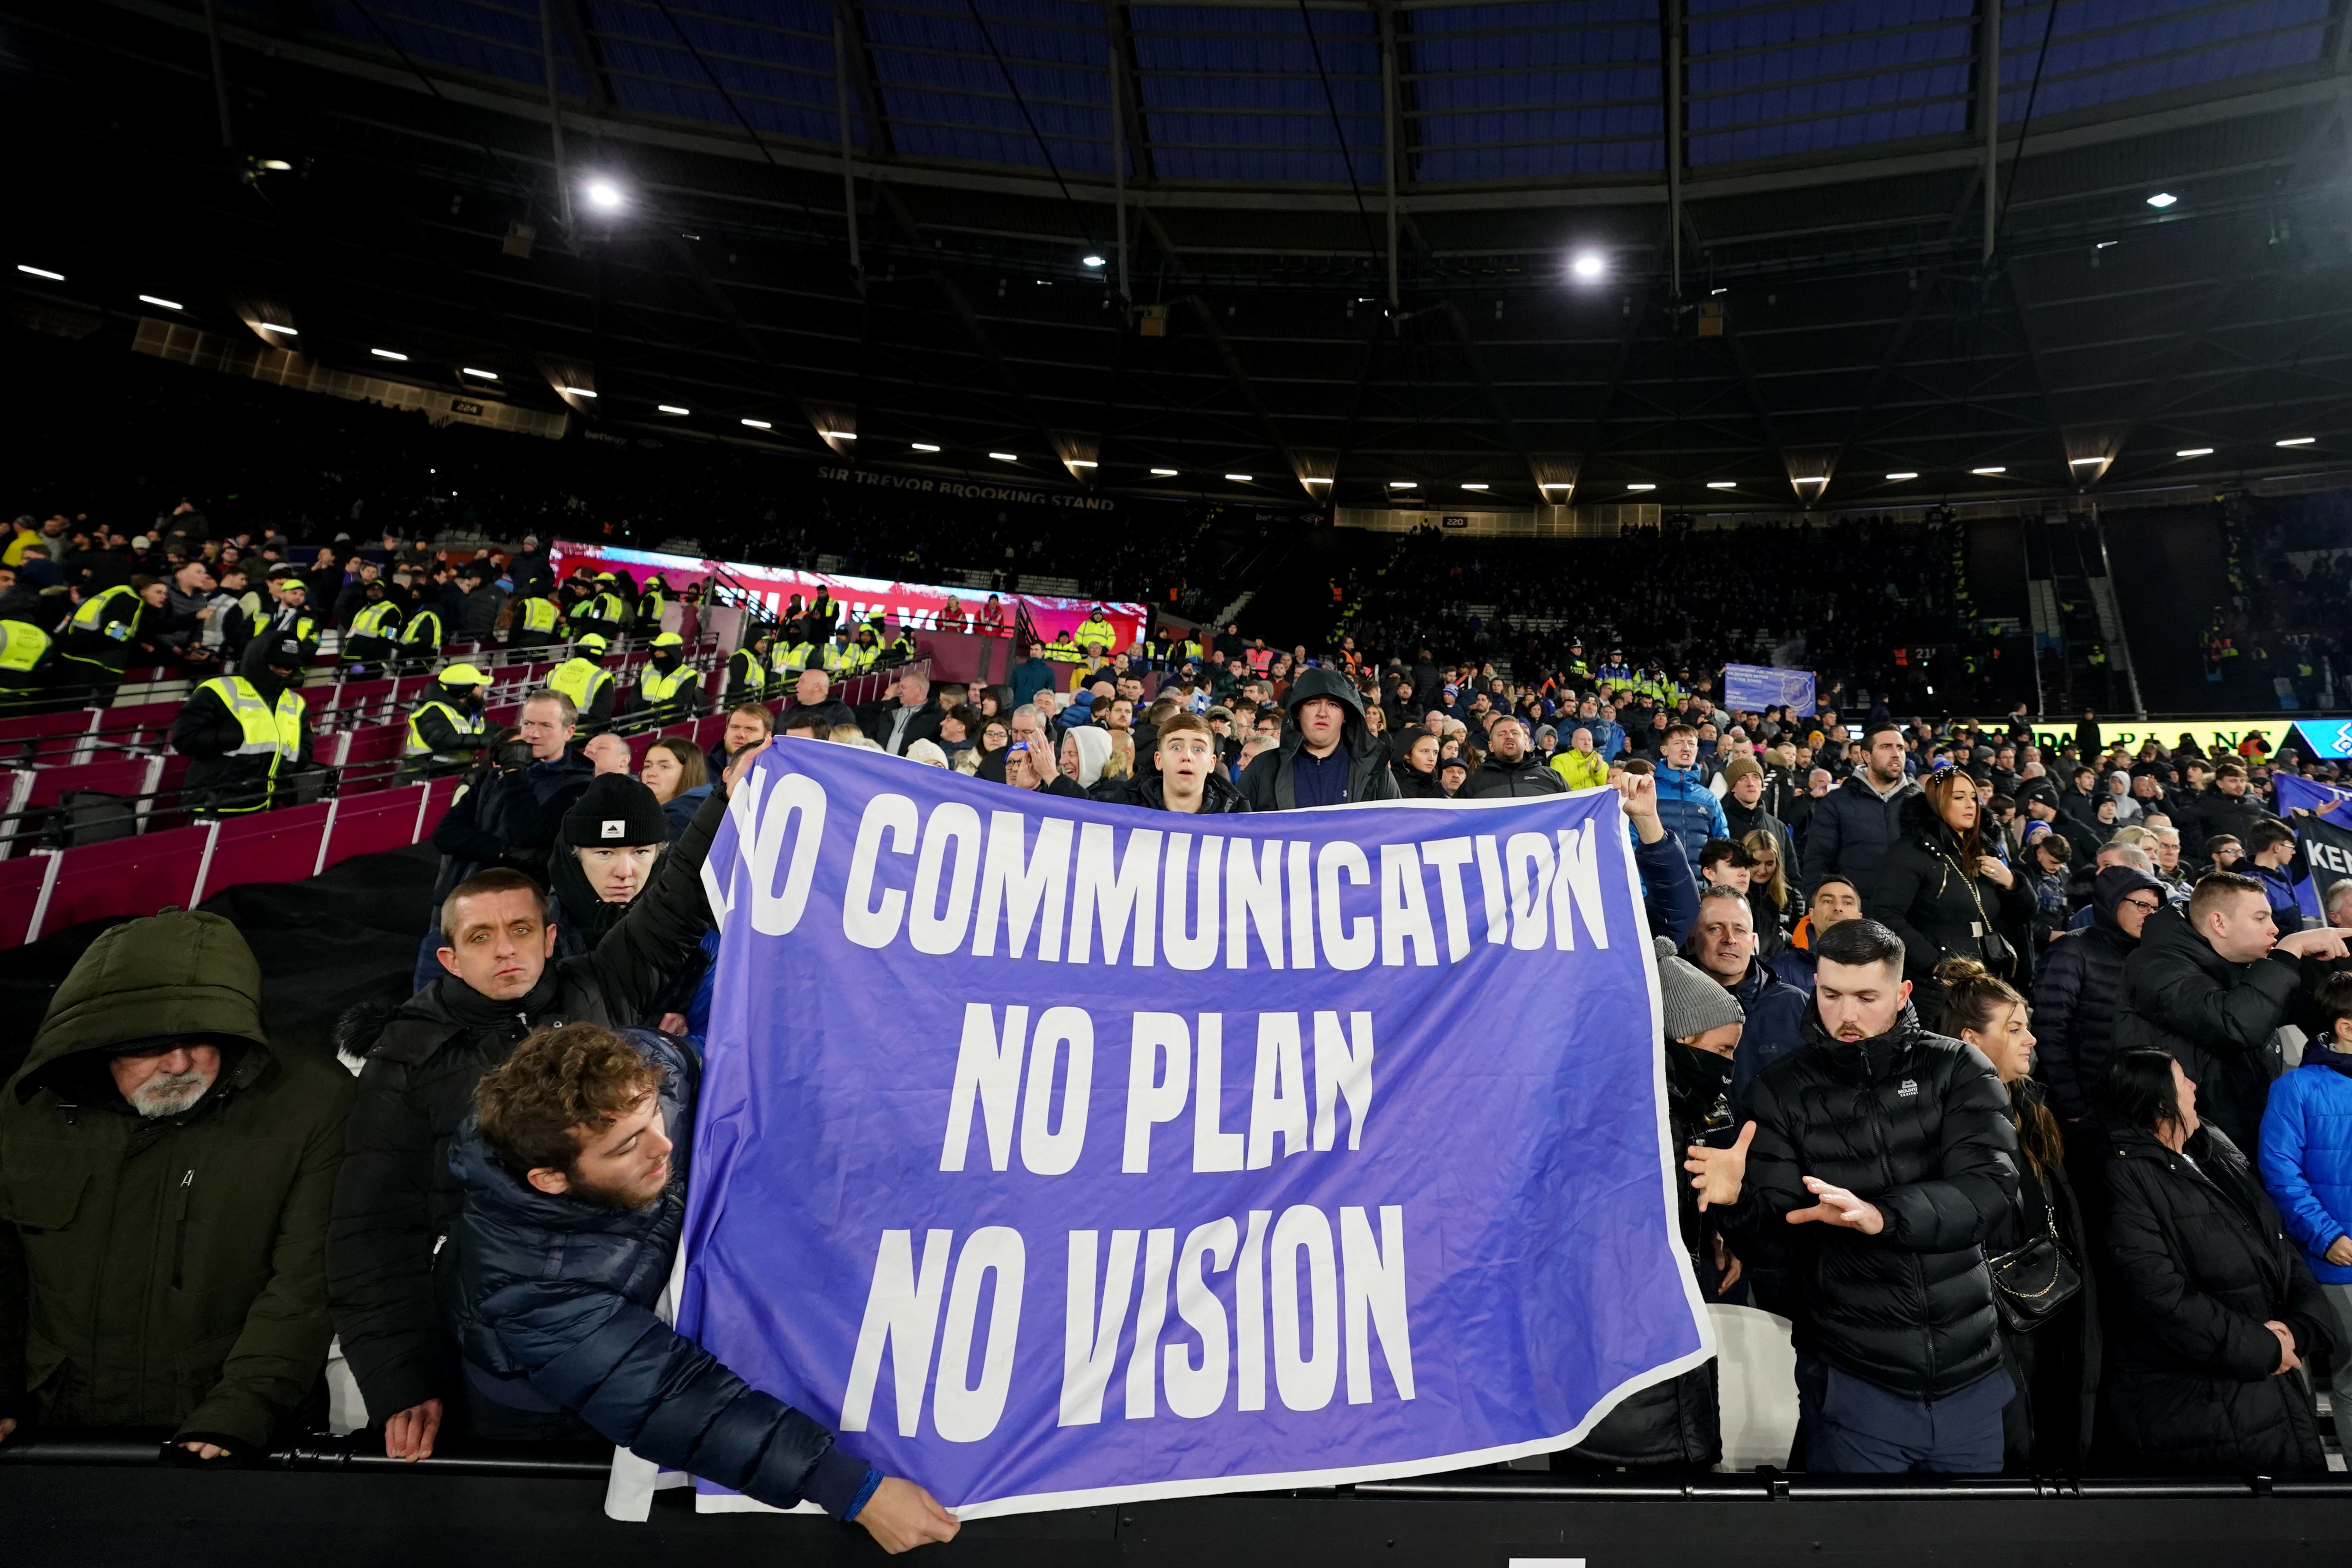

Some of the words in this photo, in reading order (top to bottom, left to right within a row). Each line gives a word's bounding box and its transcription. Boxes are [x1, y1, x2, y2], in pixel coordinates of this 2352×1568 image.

[817, 466, 848, 482] SIR
[854, 470, 933, 492] TREVOR
[938, 481, 1047, 504] BROOKING
[1051, 494, 1115, 511] STAND
[710, 765, 827, 936] NO
[843, 793, 1609, 971] COMMUNICATION
[940, 1003, 1094, 1175] NO
[1122, 1011, 1374, 1174] PLAN
[840, 1226, 1025, 1443] NO
[1058, 1204, 1416, 1427] VISION
